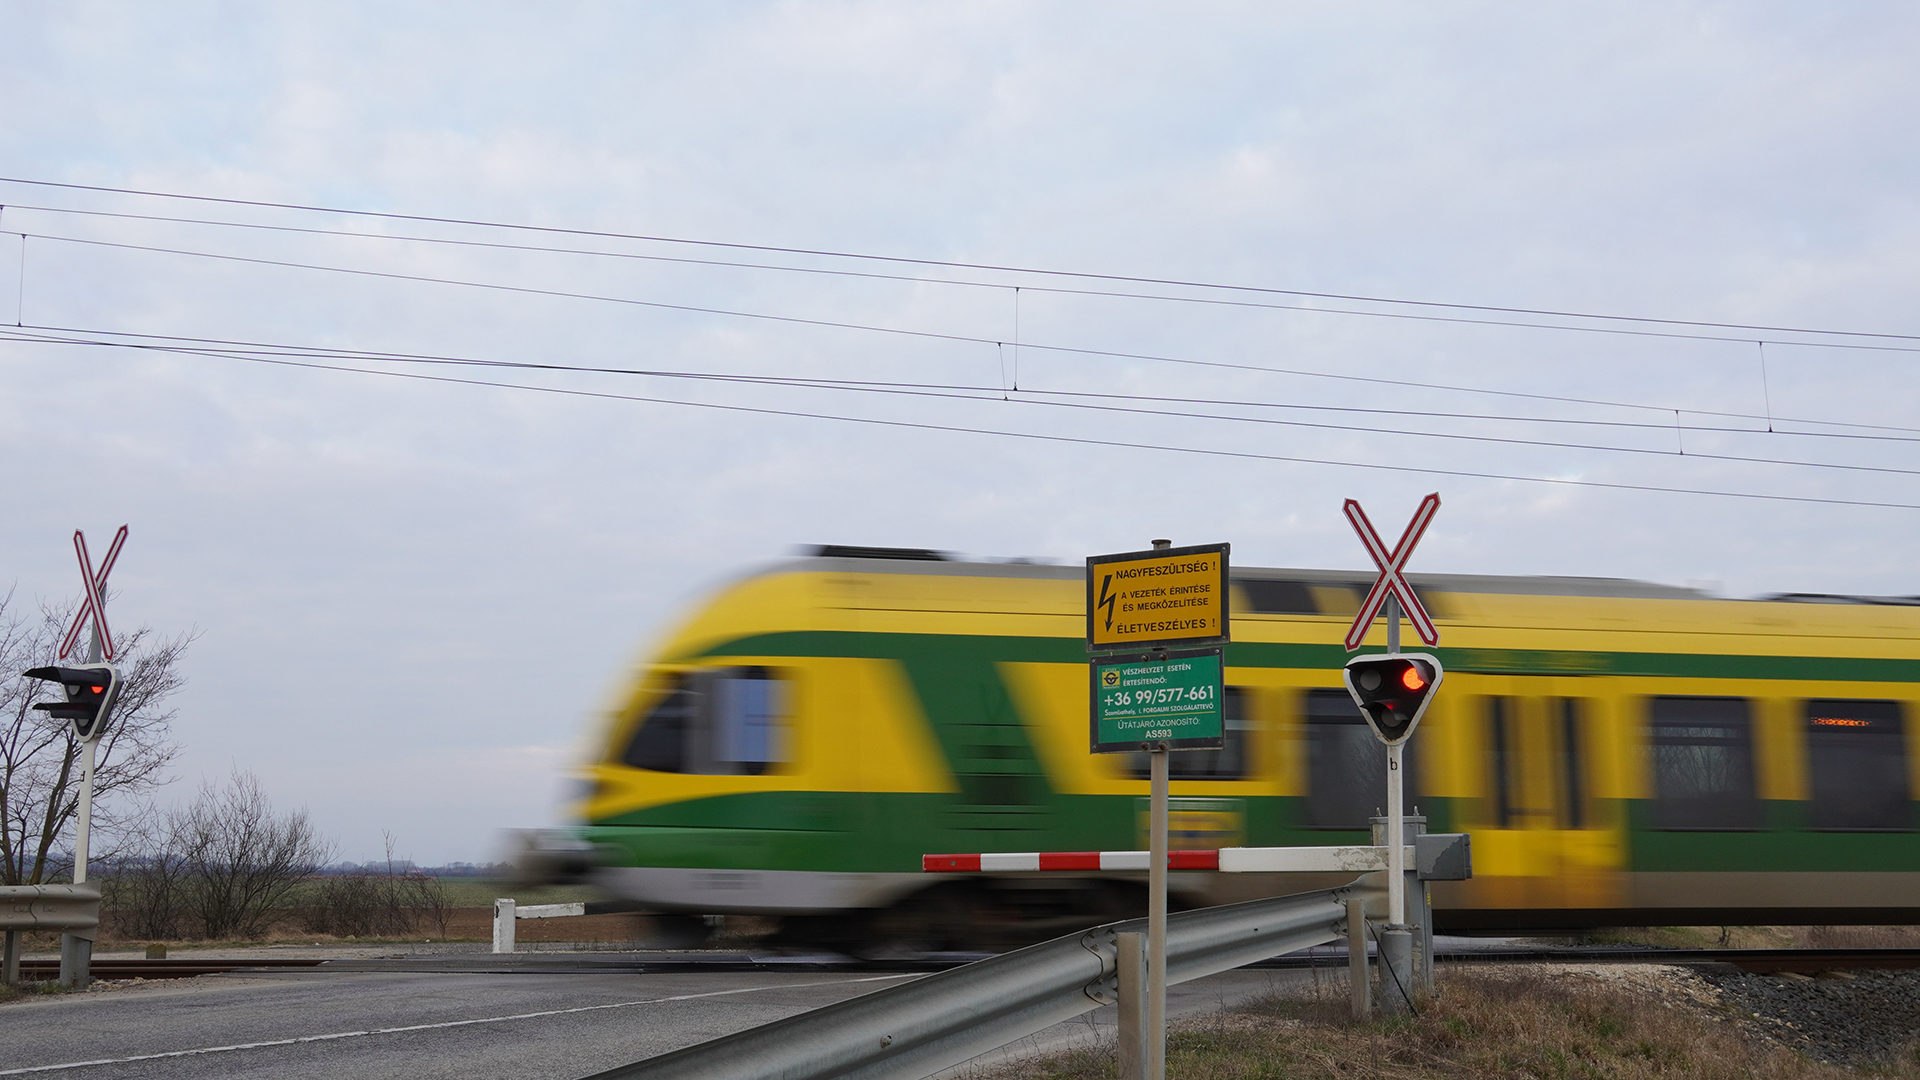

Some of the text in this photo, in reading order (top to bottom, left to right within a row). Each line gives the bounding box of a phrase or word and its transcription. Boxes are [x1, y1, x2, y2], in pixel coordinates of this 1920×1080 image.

[1116, 561, 1216, 579] NAGYFESZÜLTSÉG !
[1130, 588, 1166, 599] VEZETÉK
[1169, 584, 1211, 595] ÉRINTÉSE
[1122, 602, 1134, 612] ÉS
[1117, 618, 1216, 634] ÉLETVESZÉLYES !
[1122, 666, 1164, 675] VÉSZHELYZET
[1167, 663, 1191, 672] ESETÉN
[1104, 685, 1214, 706] +36 99/577-661
[1143, 706, 1169, 714] FORGALMI
[1156, 716, 1201, 727] AZONOSÍTÓ:
[1145, 729, 1172, 738] AS593
